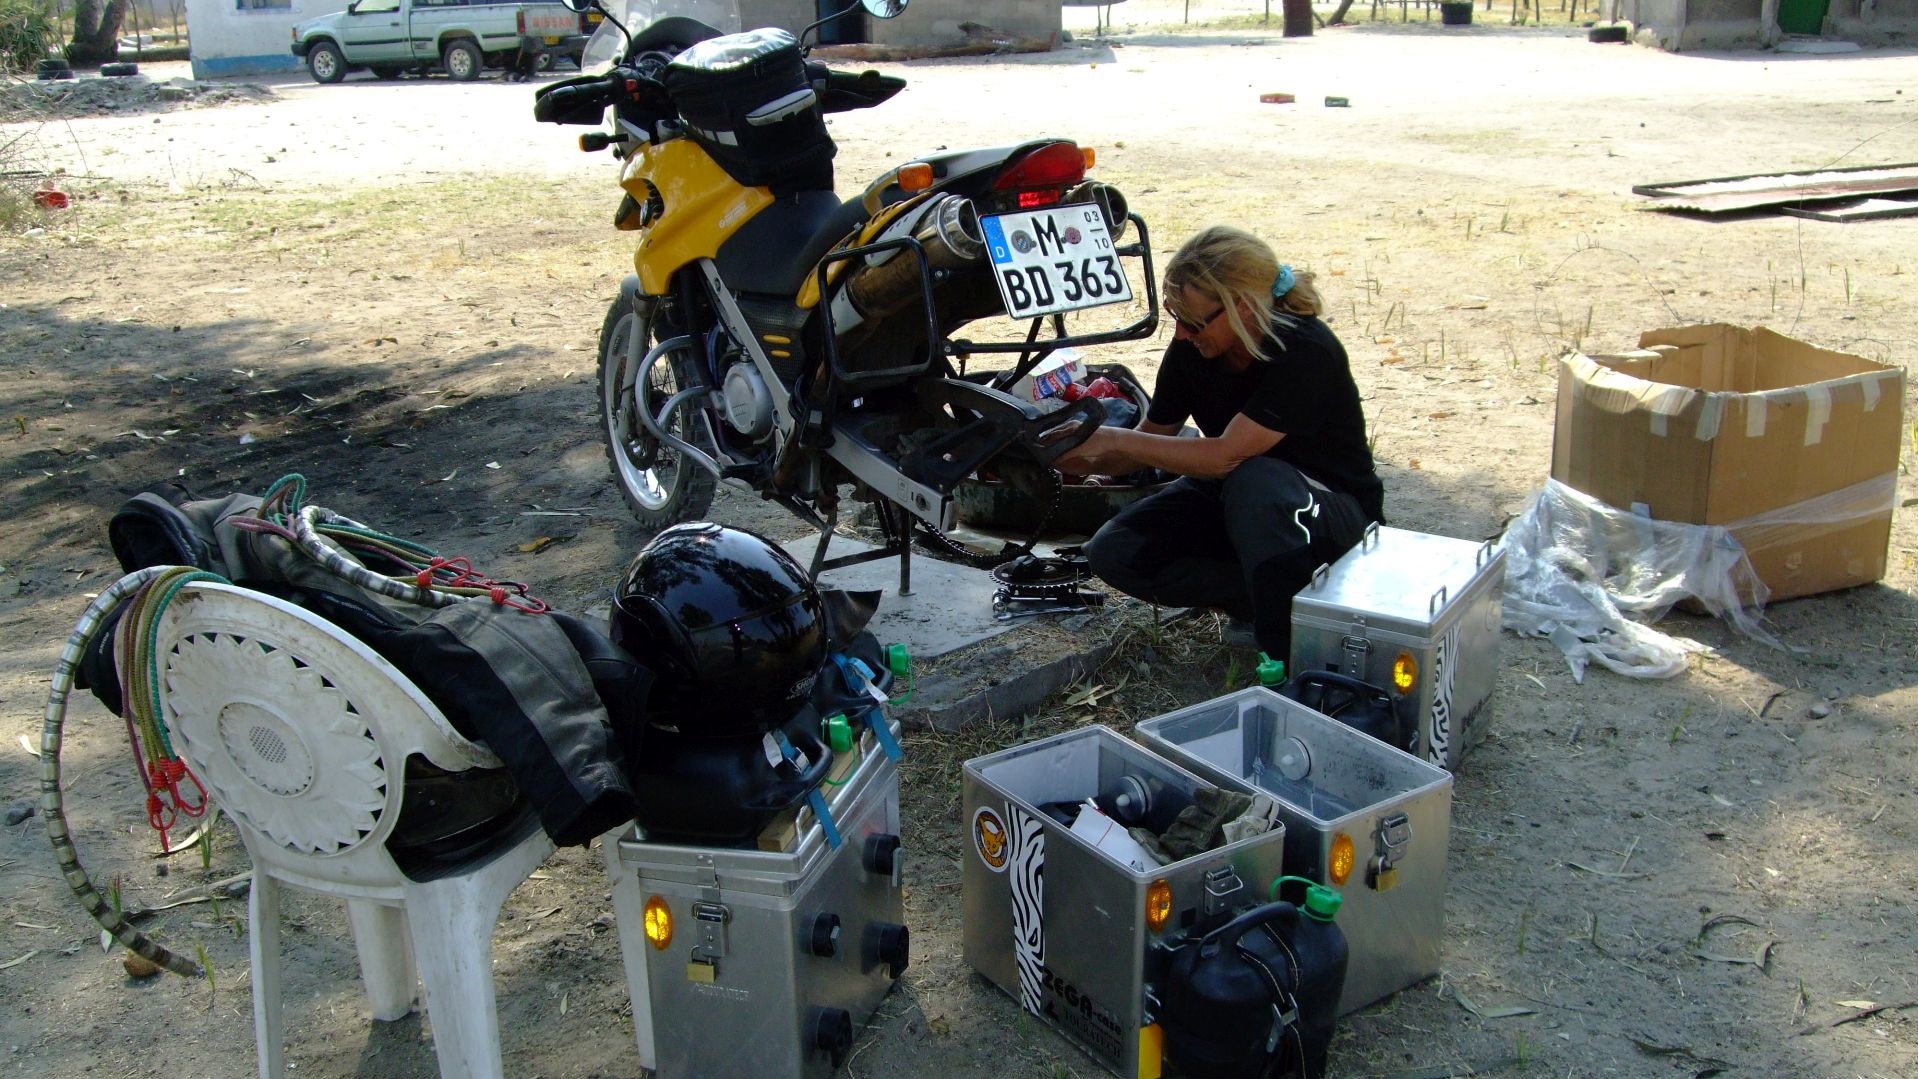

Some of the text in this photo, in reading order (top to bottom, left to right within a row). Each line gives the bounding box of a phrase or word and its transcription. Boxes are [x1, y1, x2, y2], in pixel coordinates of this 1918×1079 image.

[532, 16, 574, 28] NISSAN
[1083, 210, 1100, 223] 03
[1031, 214, 1065, 257] M
[1094, 237, 1110, 250] 10
[995, 246, 1005, 258] D
[1002, 255, 1123, 311] BD 363
